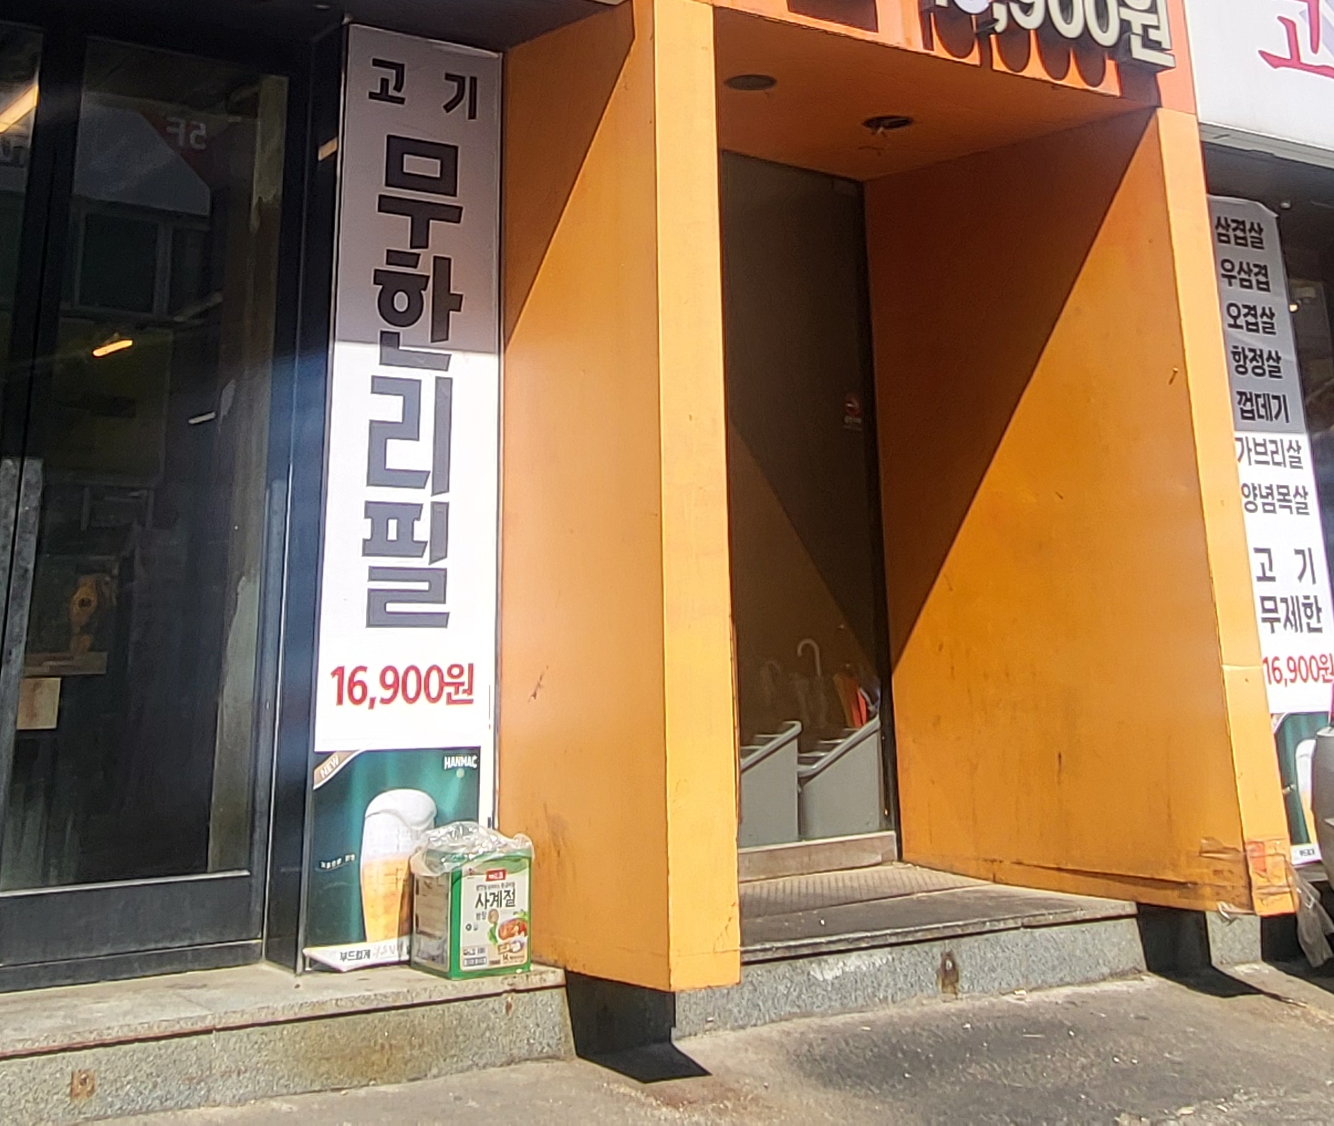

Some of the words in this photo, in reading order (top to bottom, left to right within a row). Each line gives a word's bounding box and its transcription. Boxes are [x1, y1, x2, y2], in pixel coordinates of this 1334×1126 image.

[368, 58, 478, 121] 고기
[1215, 215, 1265, 250] 삼겹살
[1220, 258, 1271, 293] 우삼겹
[1226, 302, 1277, 335] 오겹살
[1231, 345, 1283, 380] 항정살
[361, 134, 464, 629] 무한리필
[1236, 390, 1290, 424] 껍데기
[1237, 436, 1304, 470] 가브리살
[1241, 484, 1310, 516] 양념목살
[1253, 546, 1316, 585] 고기
[1260, 595, 1323, 635] 무제한
[328, 662, 475, 710] 16,900원
[1262, 654, 1334, 686] 16,900원
[319, 754, 341, 779] NEW
[443, 755, 478, 770] HANMAC
[475, 887, 516, 910] 사계절
